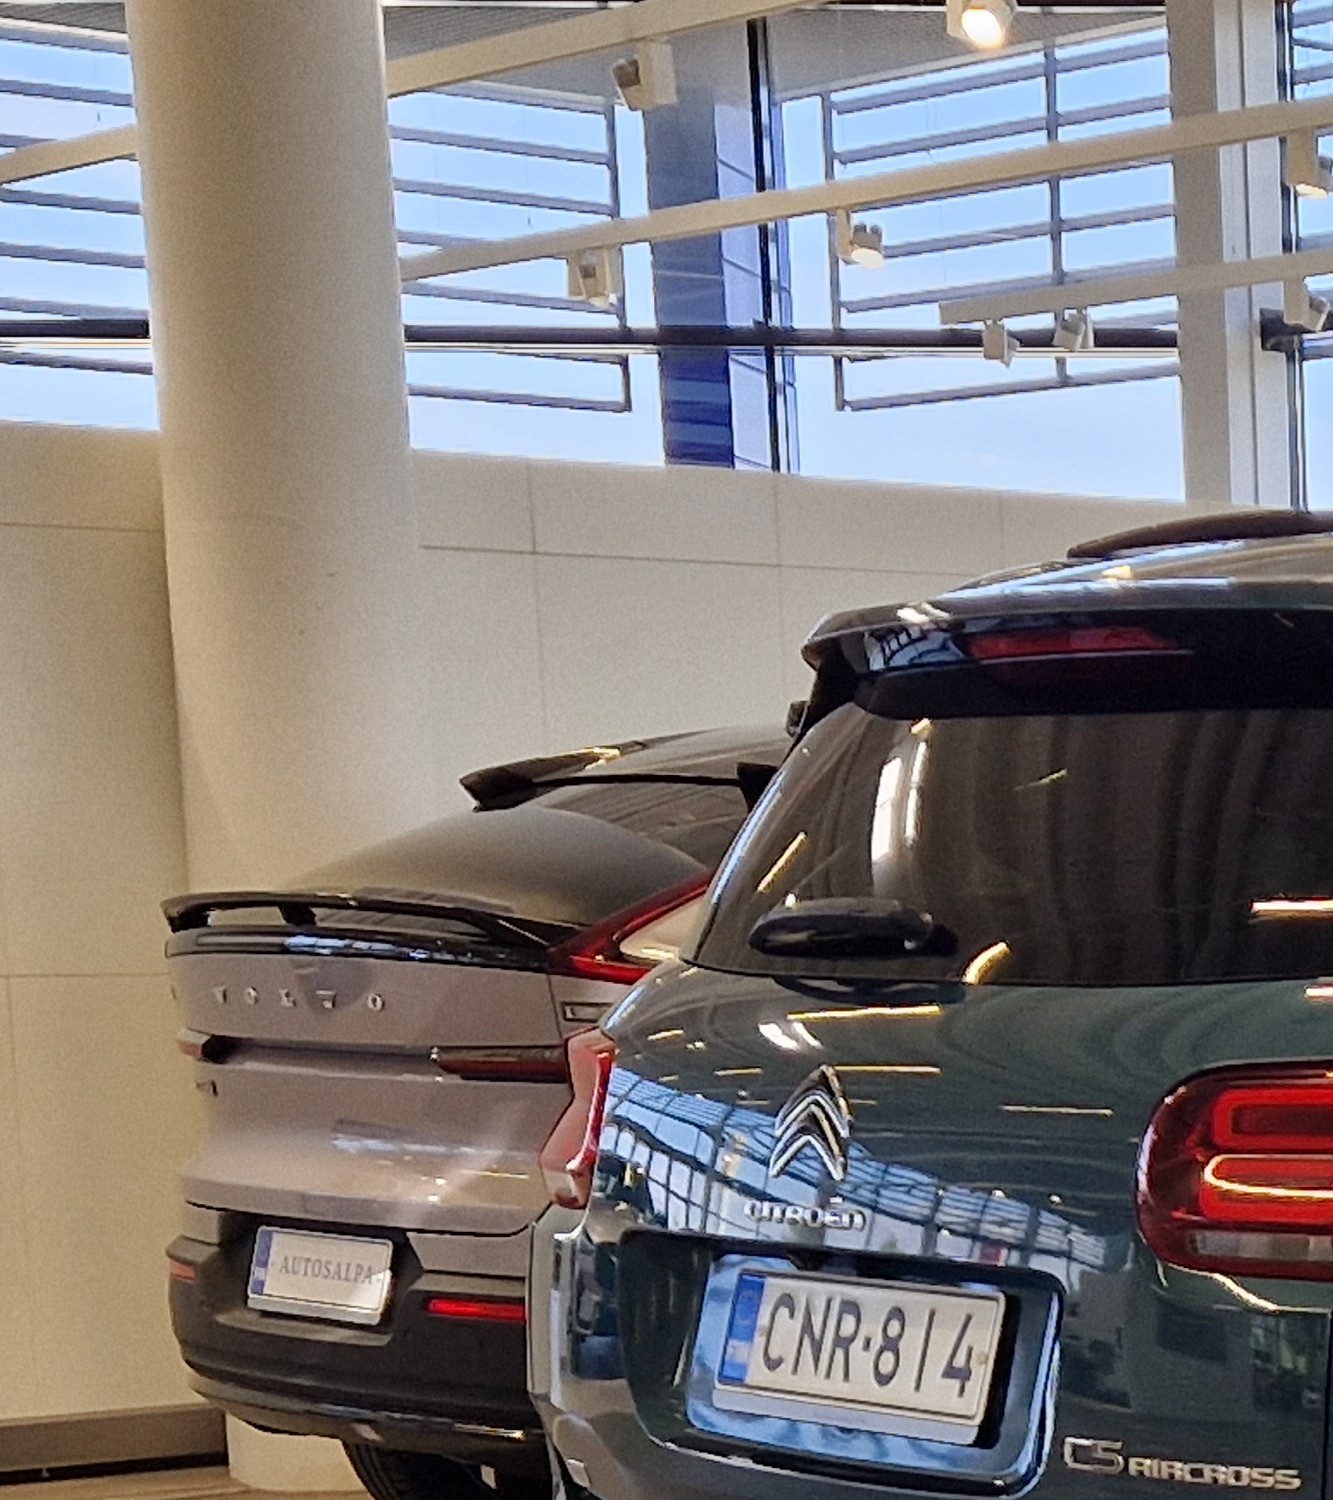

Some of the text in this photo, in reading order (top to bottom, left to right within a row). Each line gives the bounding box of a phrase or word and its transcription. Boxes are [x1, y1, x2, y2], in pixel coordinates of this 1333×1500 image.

[212, 986, 386, 1011] VOLVO
[281, 1256, 374, 1284] AUTOSALPA
[762, 1292, 973, 1398] CNR-814
[1063, 1437, 1302, 1490] C5 AIRCROSS
